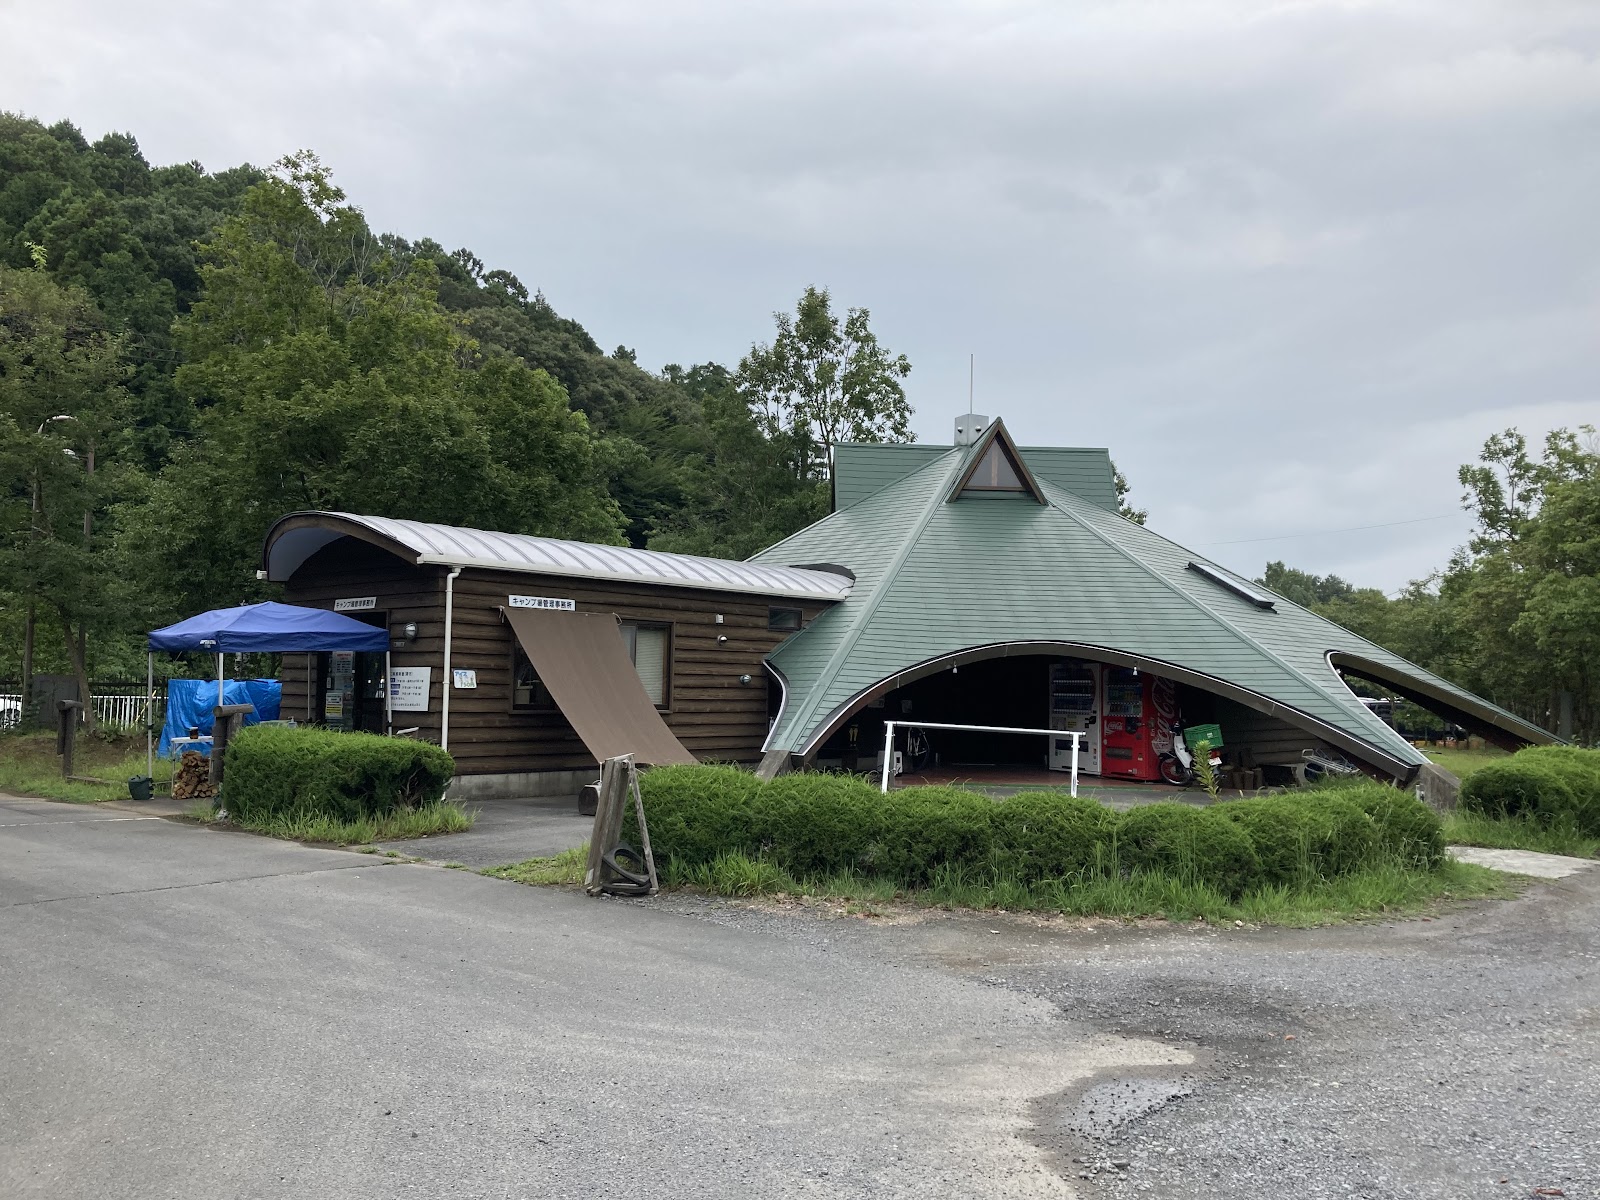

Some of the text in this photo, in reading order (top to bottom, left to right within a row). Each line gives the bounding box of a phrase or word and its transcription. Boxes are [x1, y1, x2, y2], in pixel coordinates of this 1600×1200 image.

[513, 597, 572, 609] キャンプ場管理事務所
